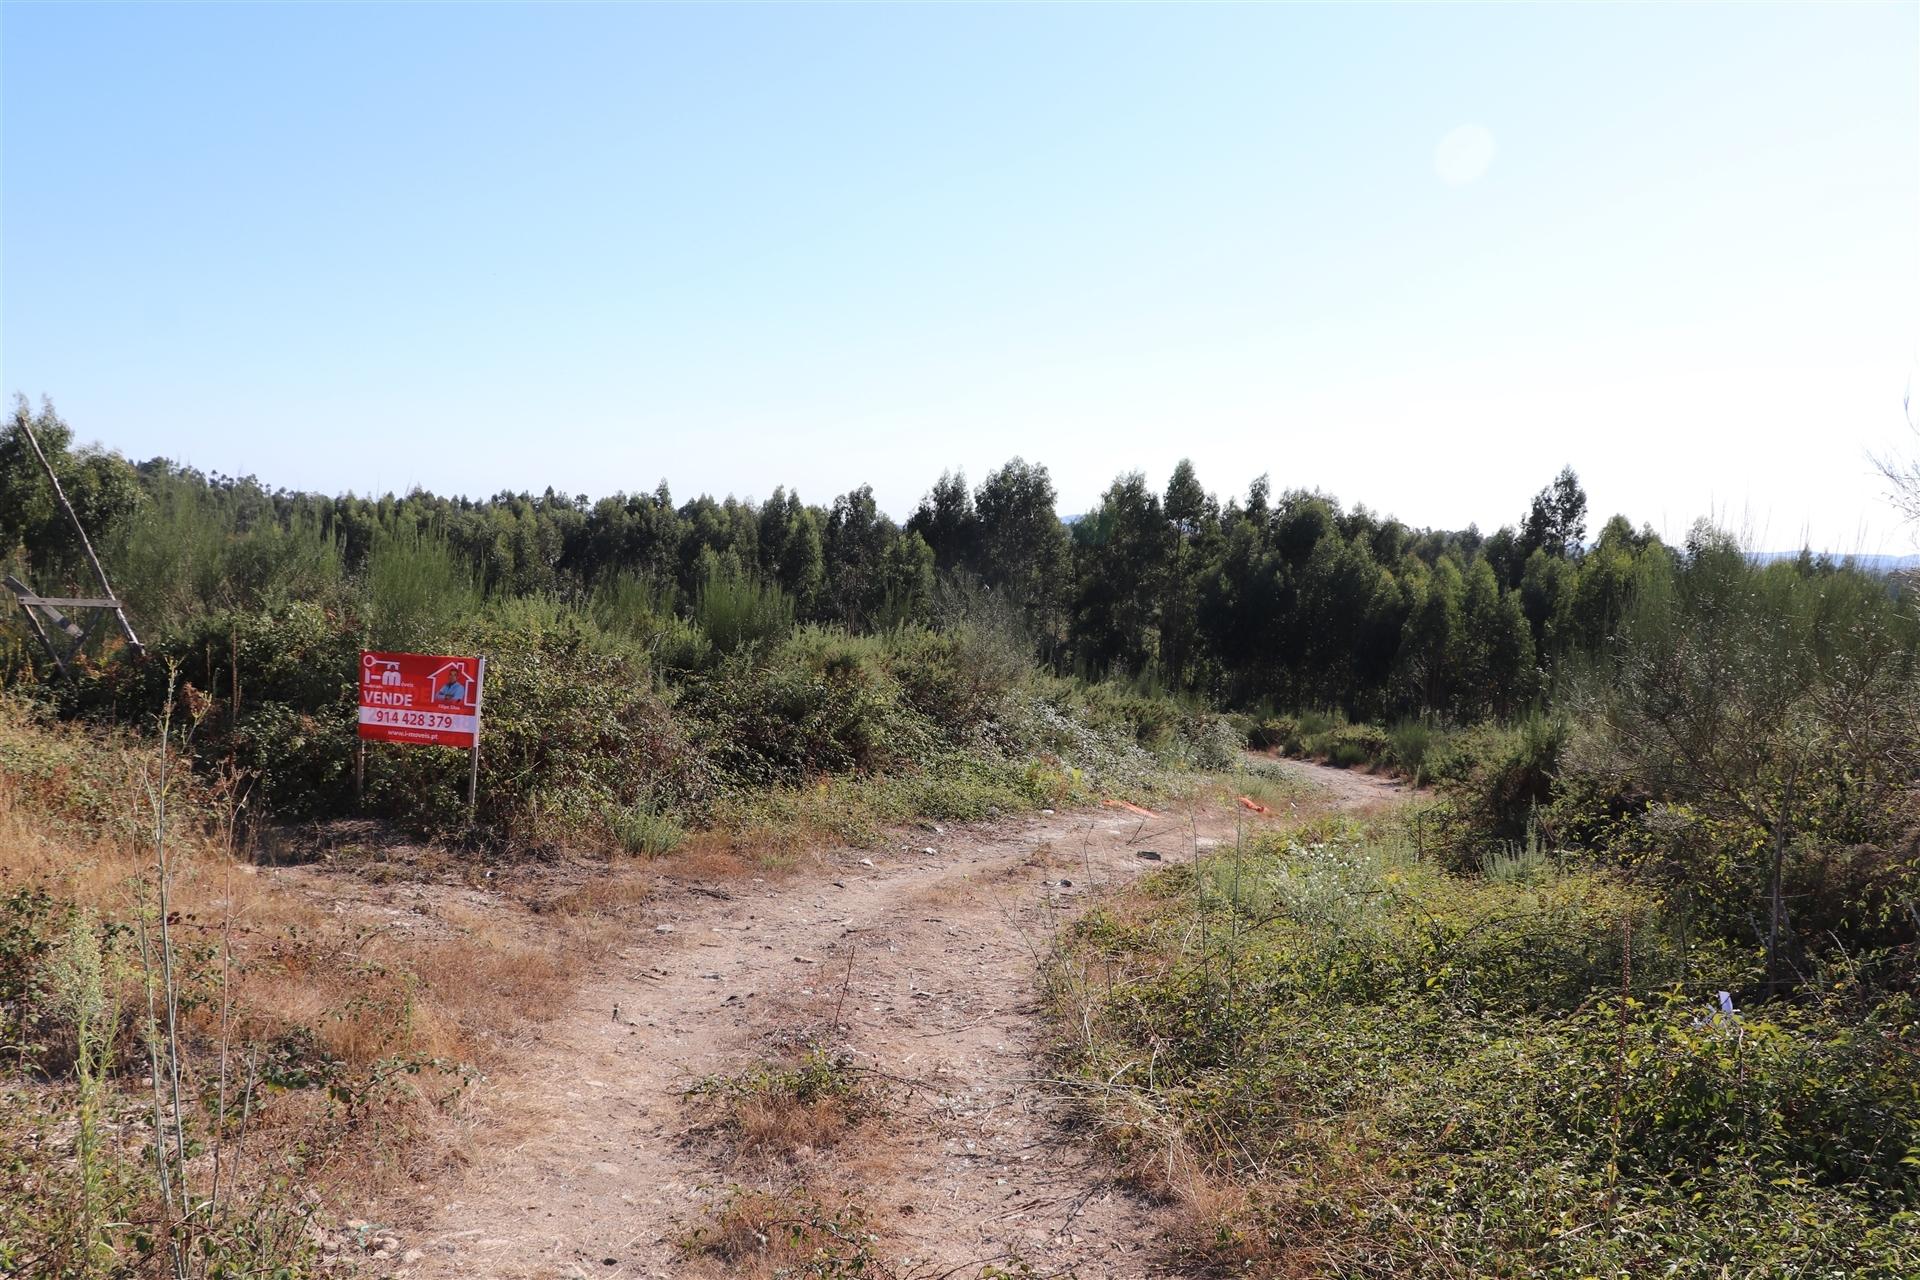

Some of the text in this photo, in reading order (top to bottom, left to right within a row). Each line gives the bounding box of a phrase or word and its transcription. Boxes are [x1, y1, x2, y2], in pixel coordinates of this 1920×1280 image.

[363, 690, 413, 706] VENDE
[376, 710, 453, 728] 914 428 379
